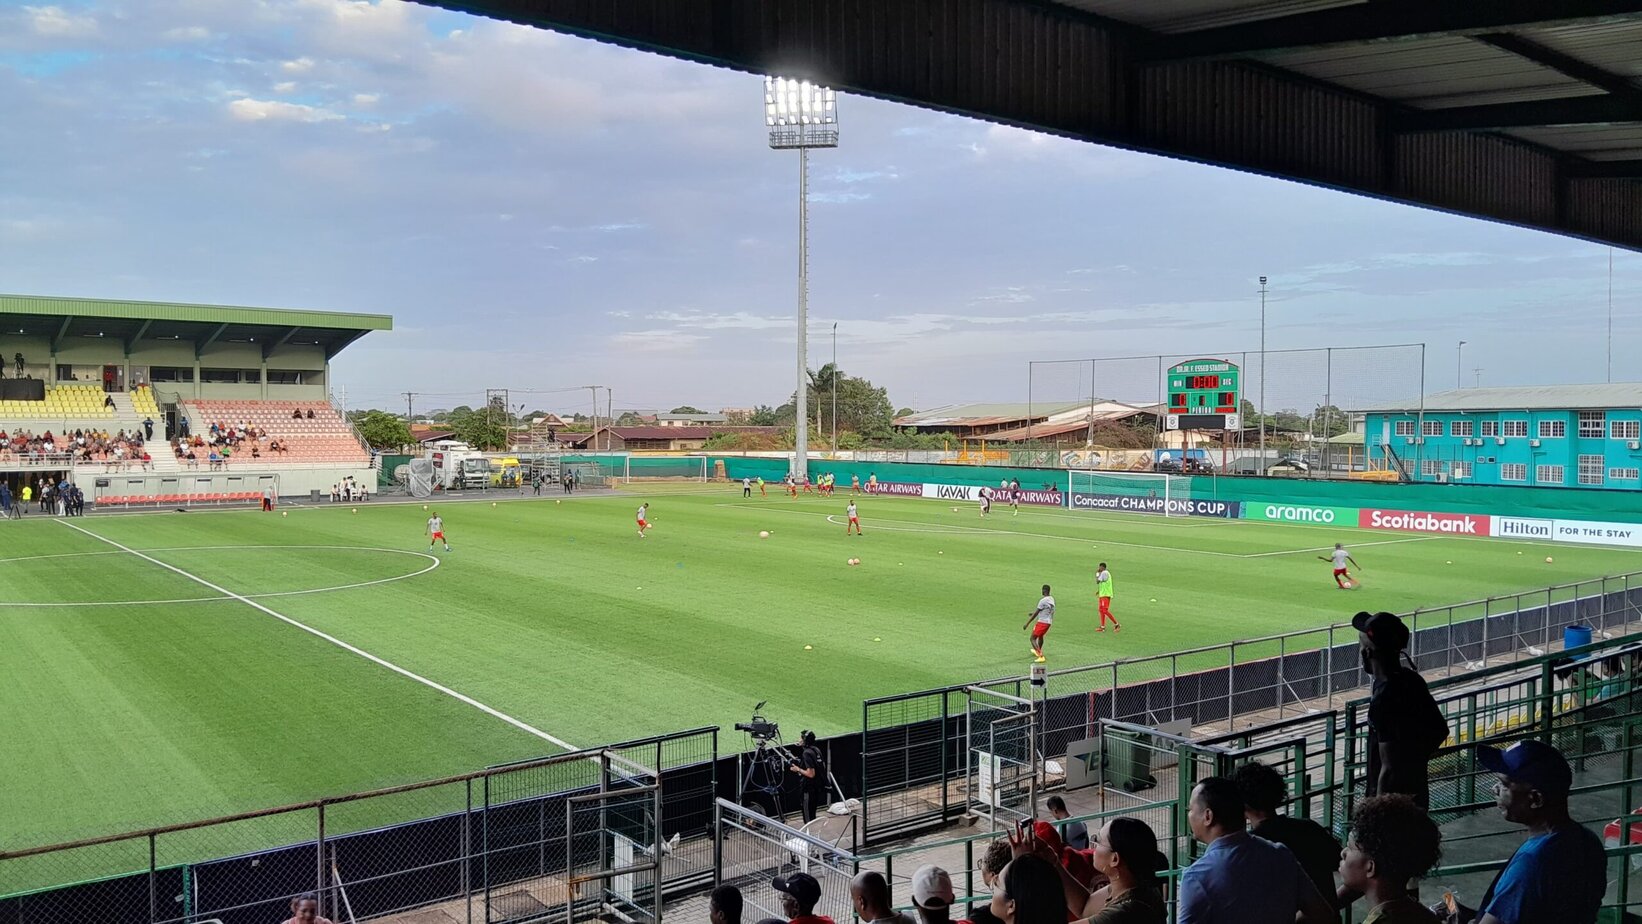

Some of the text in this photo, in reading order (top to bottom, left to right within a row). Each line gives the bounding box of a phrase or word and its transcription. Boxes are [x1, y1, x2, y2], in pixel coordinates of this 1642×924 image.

[864, 482, 921, 495] QTAR AIRWAYS
[937, 485, 971, 499] KAVAK
[990, 490, 1061, 504] QATA AIRWAYS
[1074, 494, 1119, 508] Concacaf
[1197, 502, 1225, 514] CUP
[1265, 505, 1335, 523] aramco
[1370, 510, 1476, 534] Scotiabank
[1503, 521, 1632, 538] Hilton FOR THE STAY
